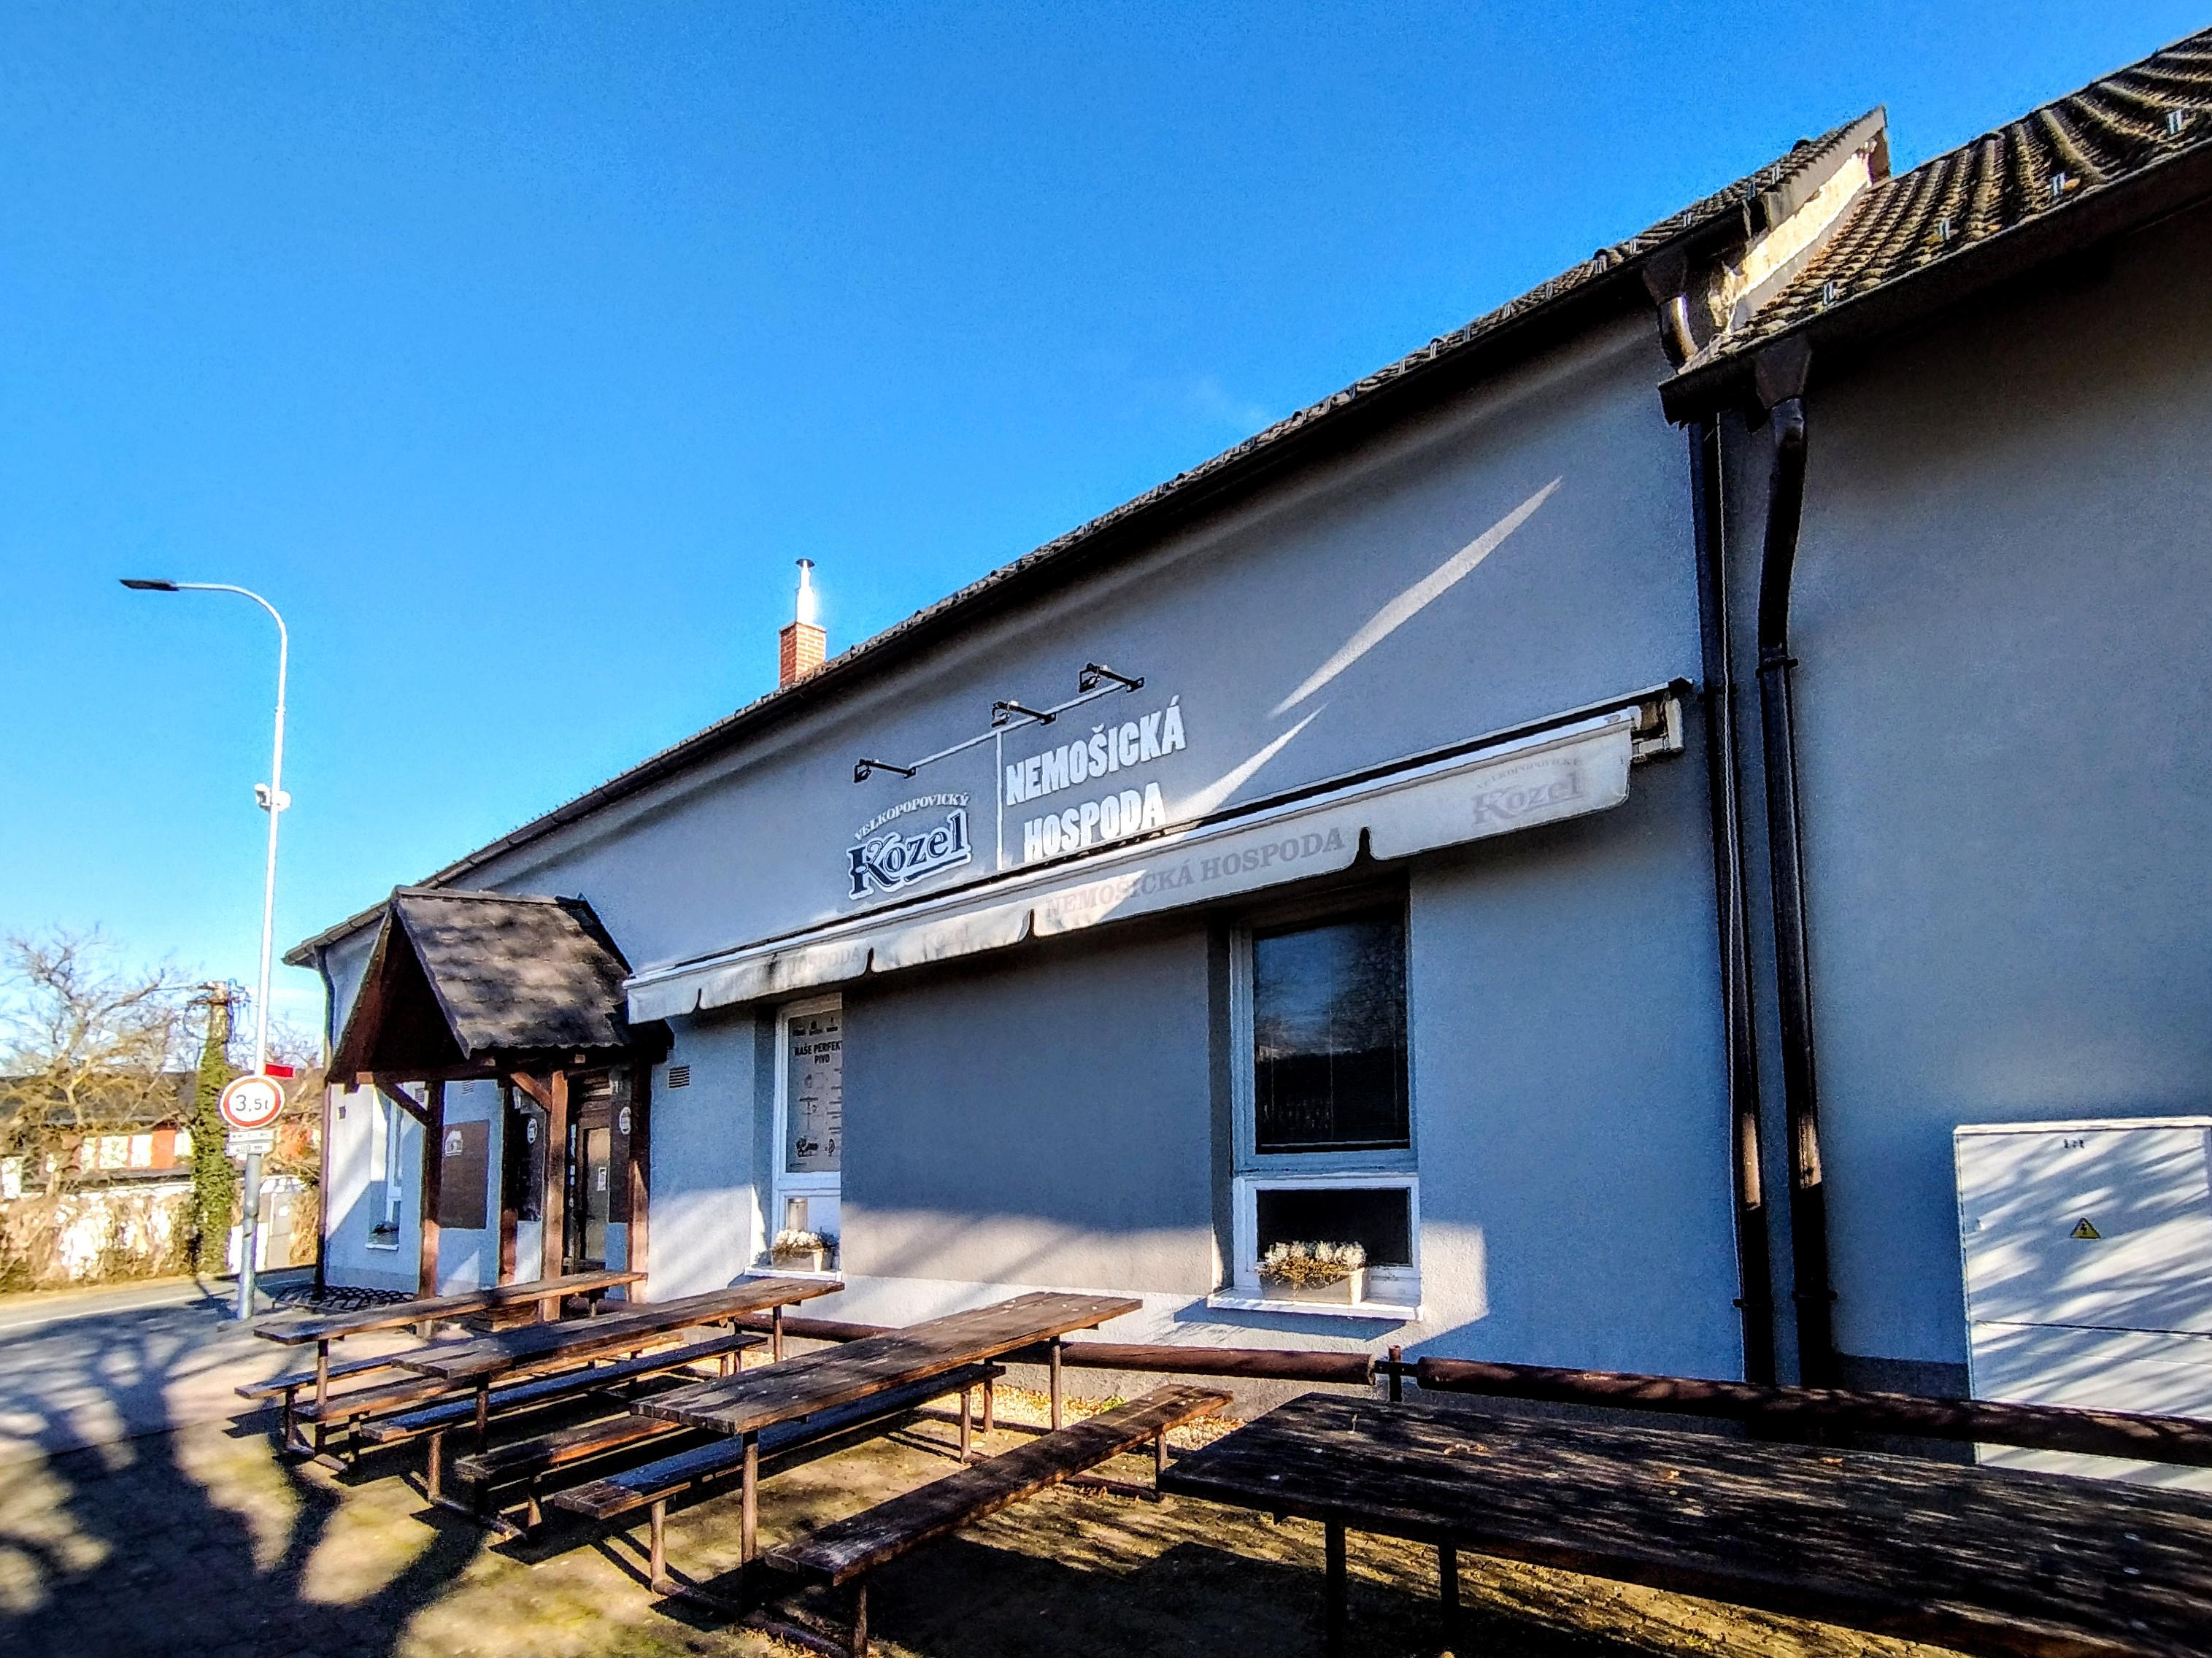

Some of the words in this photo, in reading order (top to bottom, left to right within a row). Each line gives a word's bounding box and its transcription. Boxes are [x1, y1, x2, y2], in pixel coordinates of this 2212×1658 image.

[1005, 695, 1188, 806] NEMOŠICKÁ
[854, 791, 970, 841] VELKOPOPOVICKÝ
[1023, 782, 1167, 863] HOSPODA
[1471, 770, 1586, 825] Kozel
[847, 809, 971, 898] Kozel
[1199, 827, 1346, 882] HOSPODA
[814, 1040, 842, 1054] PERFEK
[814, 1053, 831, 1065] PIVO
